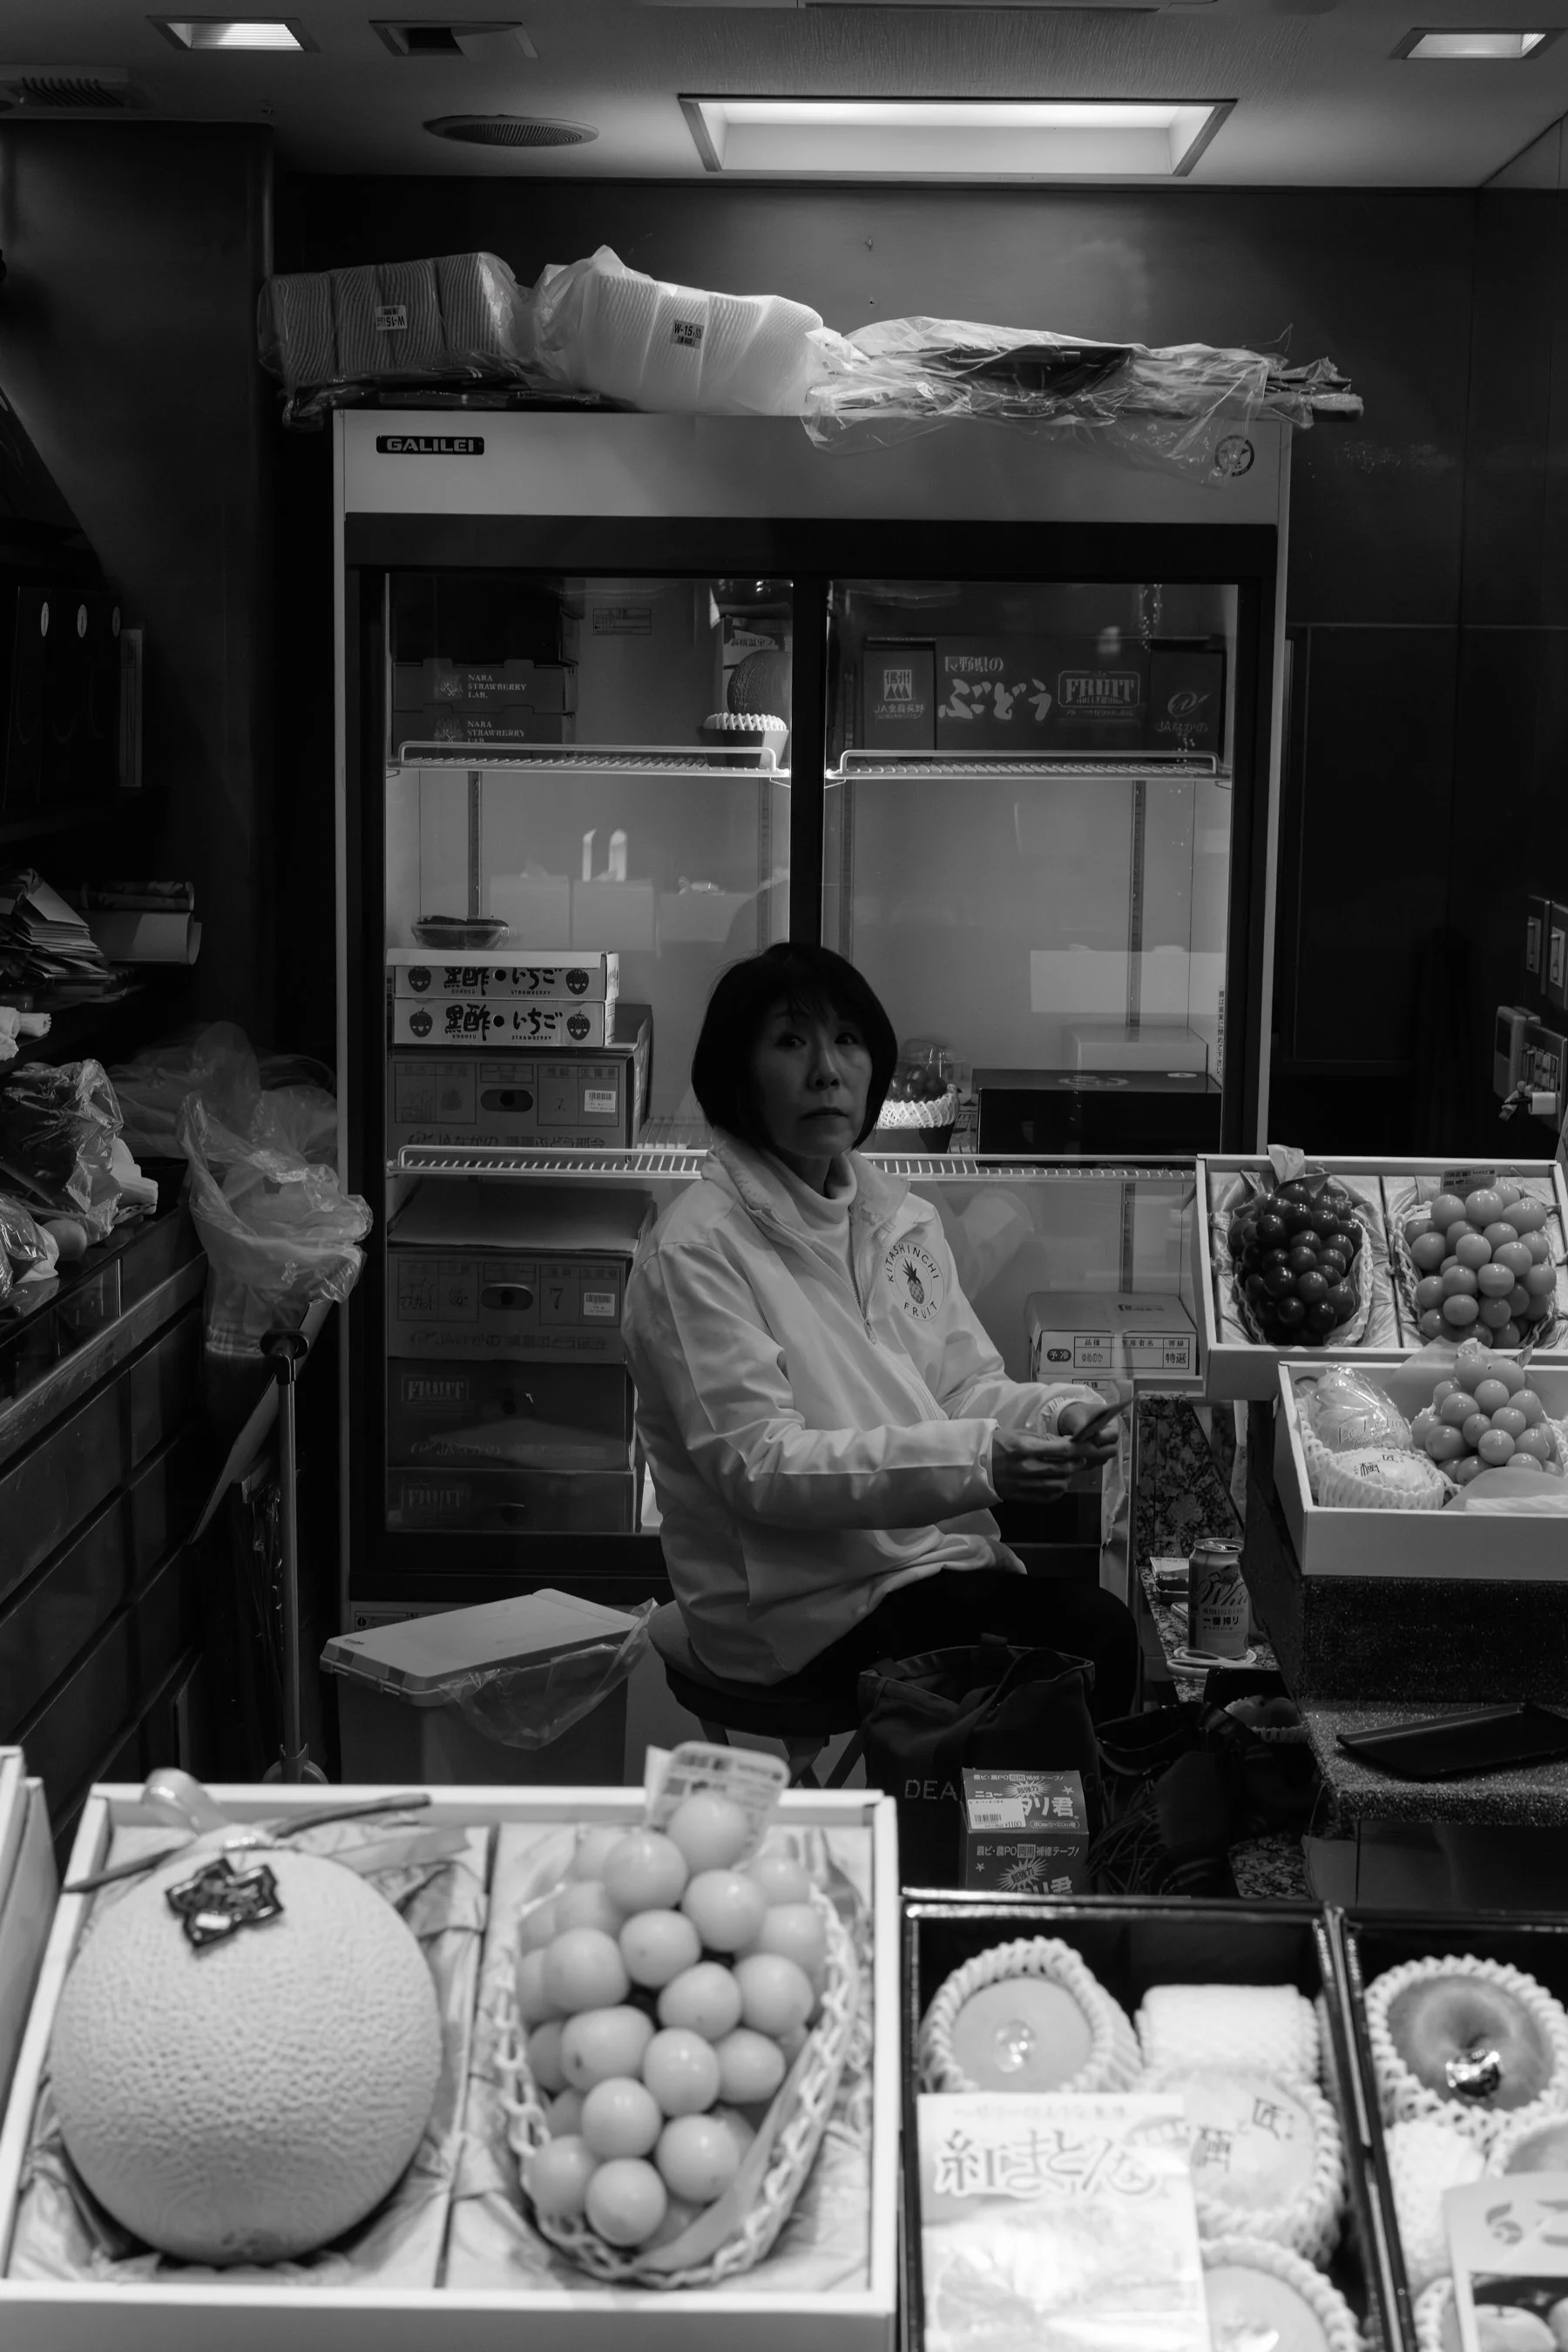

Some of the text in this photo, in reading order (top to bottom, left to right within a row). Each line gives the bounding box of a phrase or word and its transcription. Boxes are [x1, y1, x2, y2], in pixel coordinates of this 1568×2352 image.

[674, 322, 693, 336] W-15
[386, 437, 474, 453] GALILEI
[944, 656, 1004, 672] 長野県の
[468, 673, 493, 682] NARA
[937, 678, 1052, 721] ぶどう
[1065, 679, 1134, 704] FRUIT
[885, 1243, 939, 1282] KITASHINCHI
[904, 1301, 937, 1320] FRUIT
[1081, 1352, 1104, 1363] ゆめのか
[1165, 1352, 1186, 1364] 特選
[904, 1779, 958, 1801] DEA
[975, 1790, 1004, 1799] ニュー
